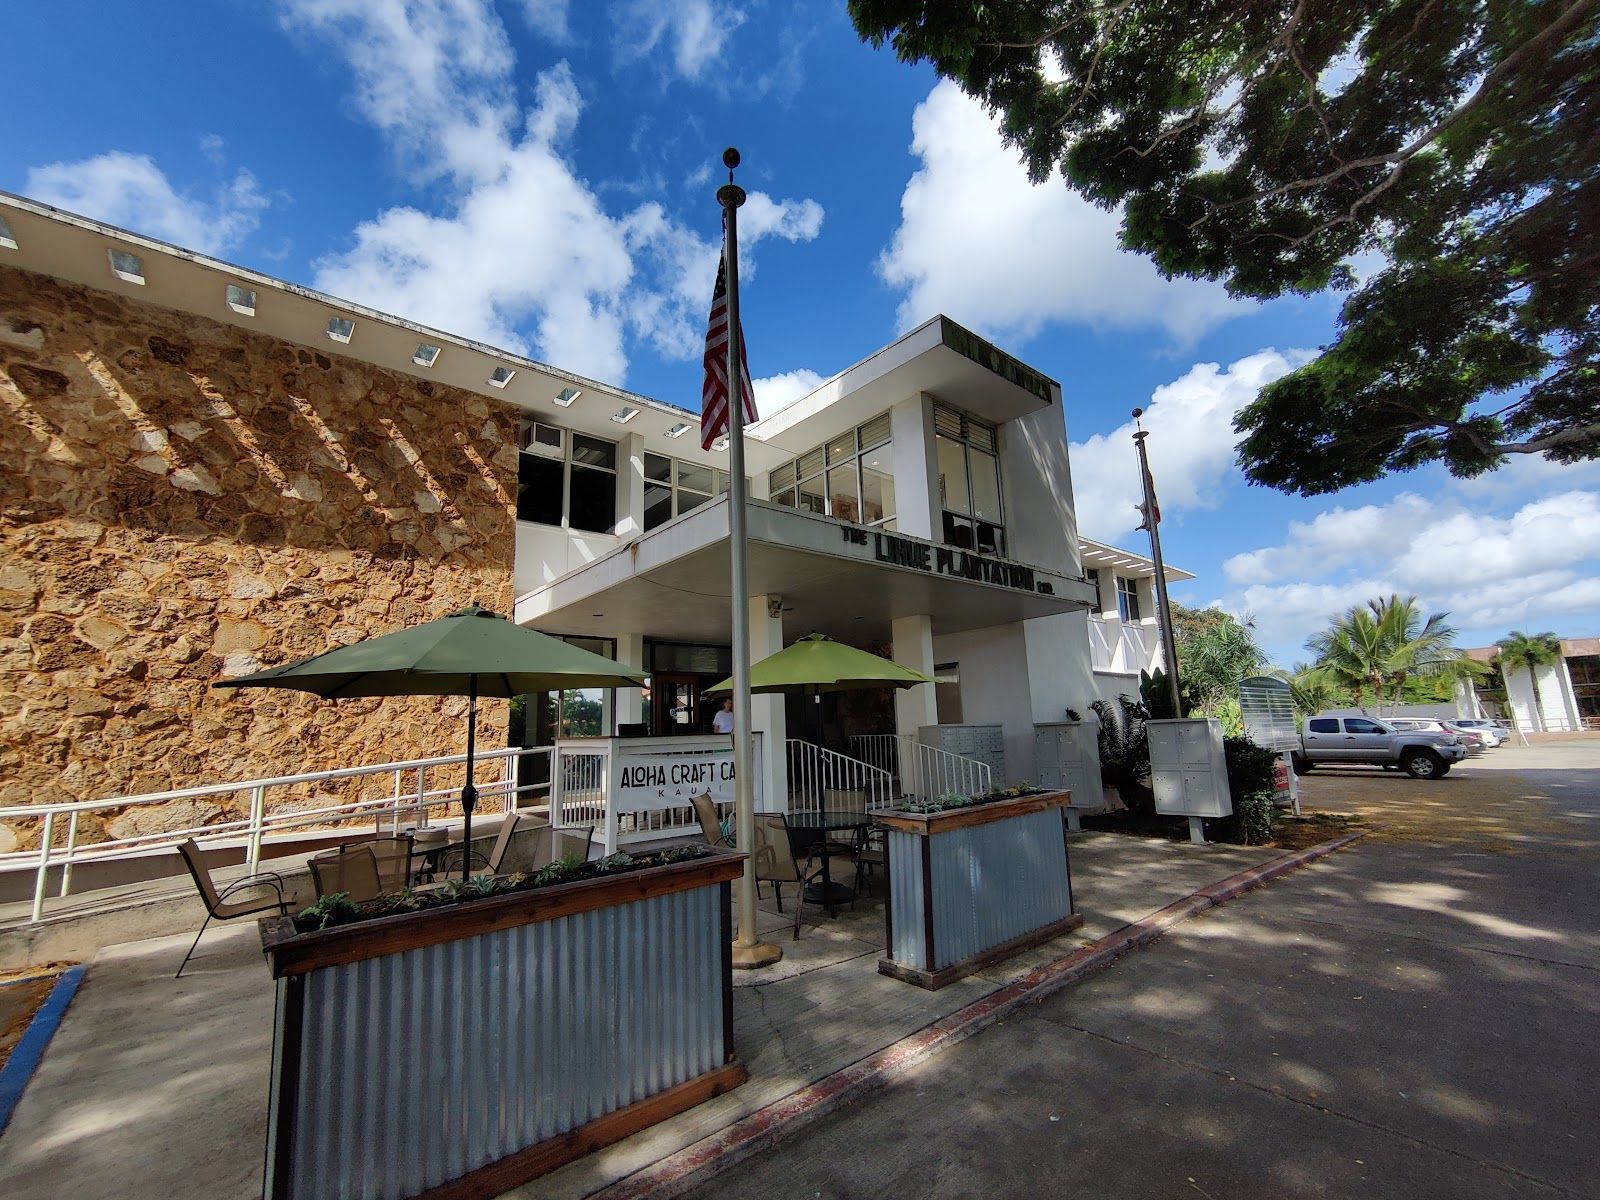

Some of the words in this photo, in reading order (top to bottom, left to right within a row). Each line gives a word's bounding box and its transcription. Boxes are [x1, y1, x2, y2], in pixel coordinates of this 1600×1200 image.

[841, 526, 868, 545] THE
[875, 532, 932, 571] LIHUE
[936, 547, 1035, 591] PLANTATION
[620, 765, 666, 789] ALOHA
[671, 762, 716, 785] CRAFT
[720, 761, 736, 781] CA
[658, 786, 722, 797] KAUAI
